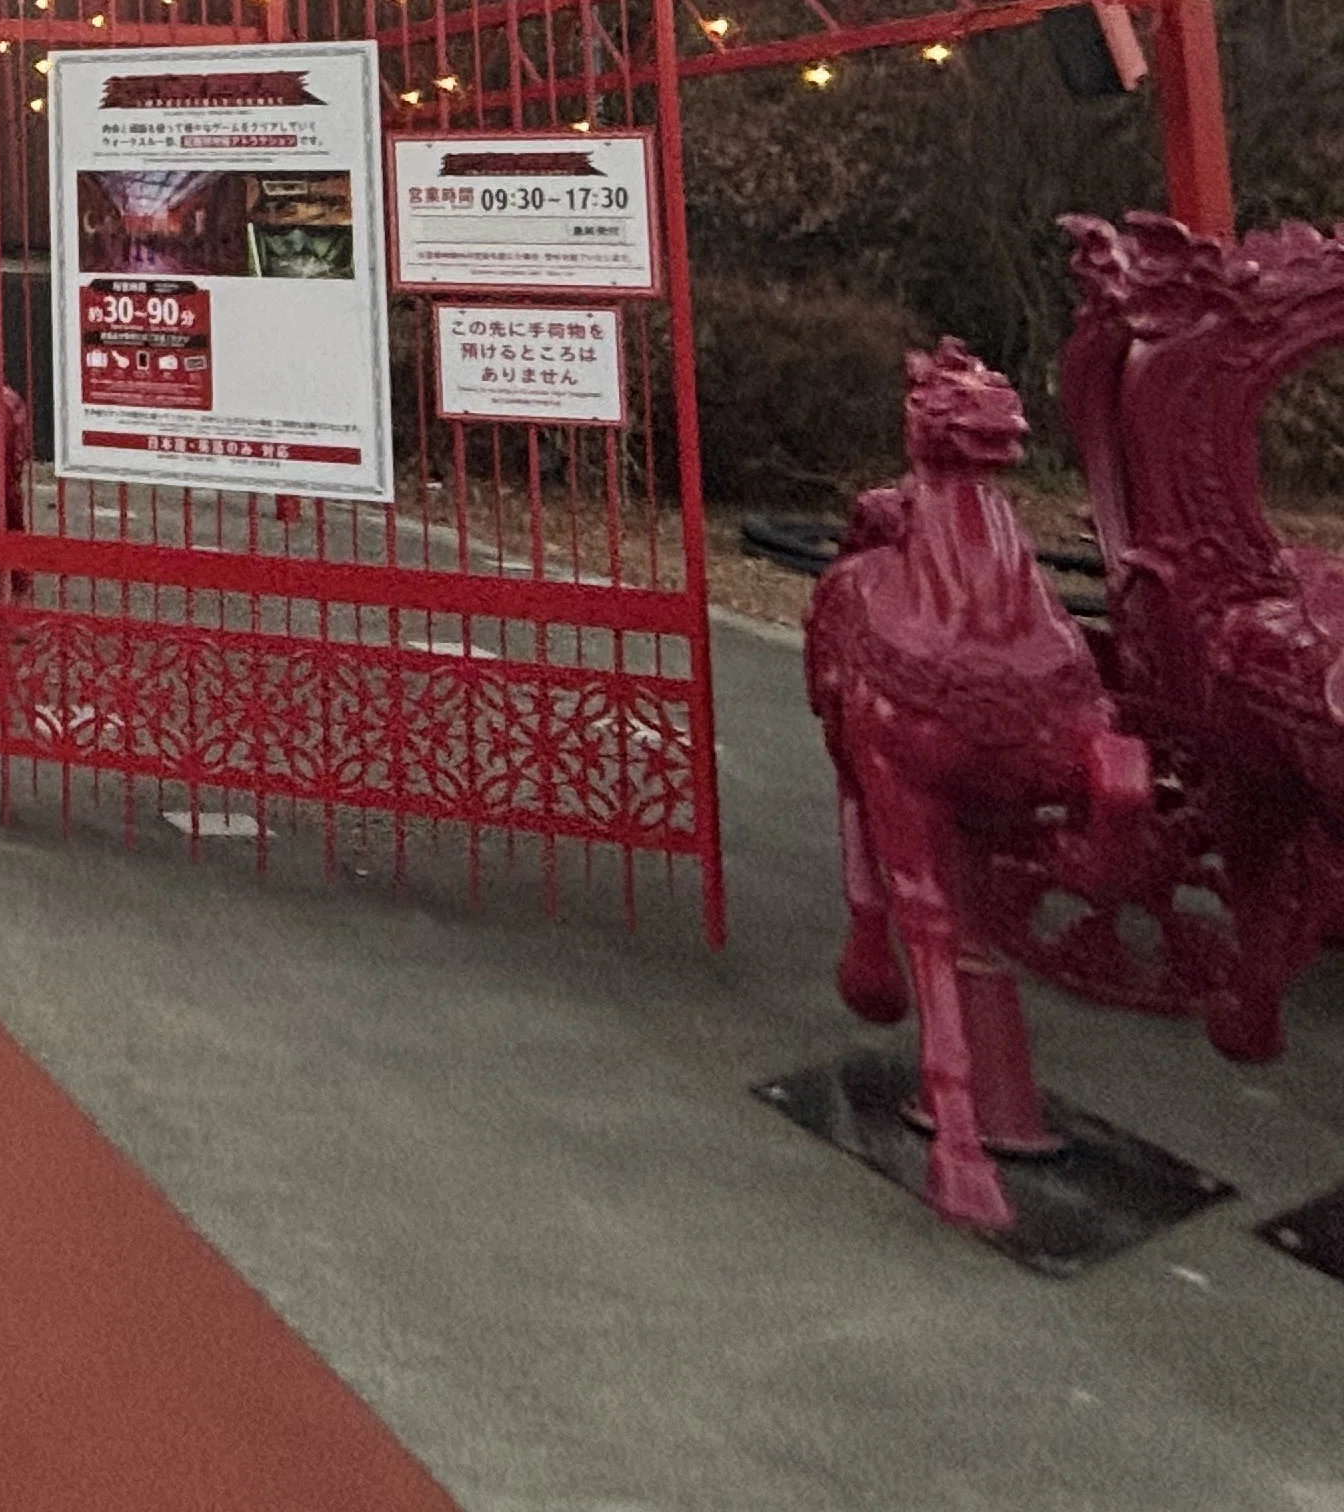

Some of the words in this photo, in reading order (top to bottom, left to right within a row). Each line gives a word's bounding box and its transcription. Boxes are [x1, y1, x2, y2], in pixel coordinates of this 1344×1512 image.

[451, 320, 604, 340] この先に手荷物を
[460, 342, 598, 362] 預けるところは
[481, 366, 578, 386] ありません
